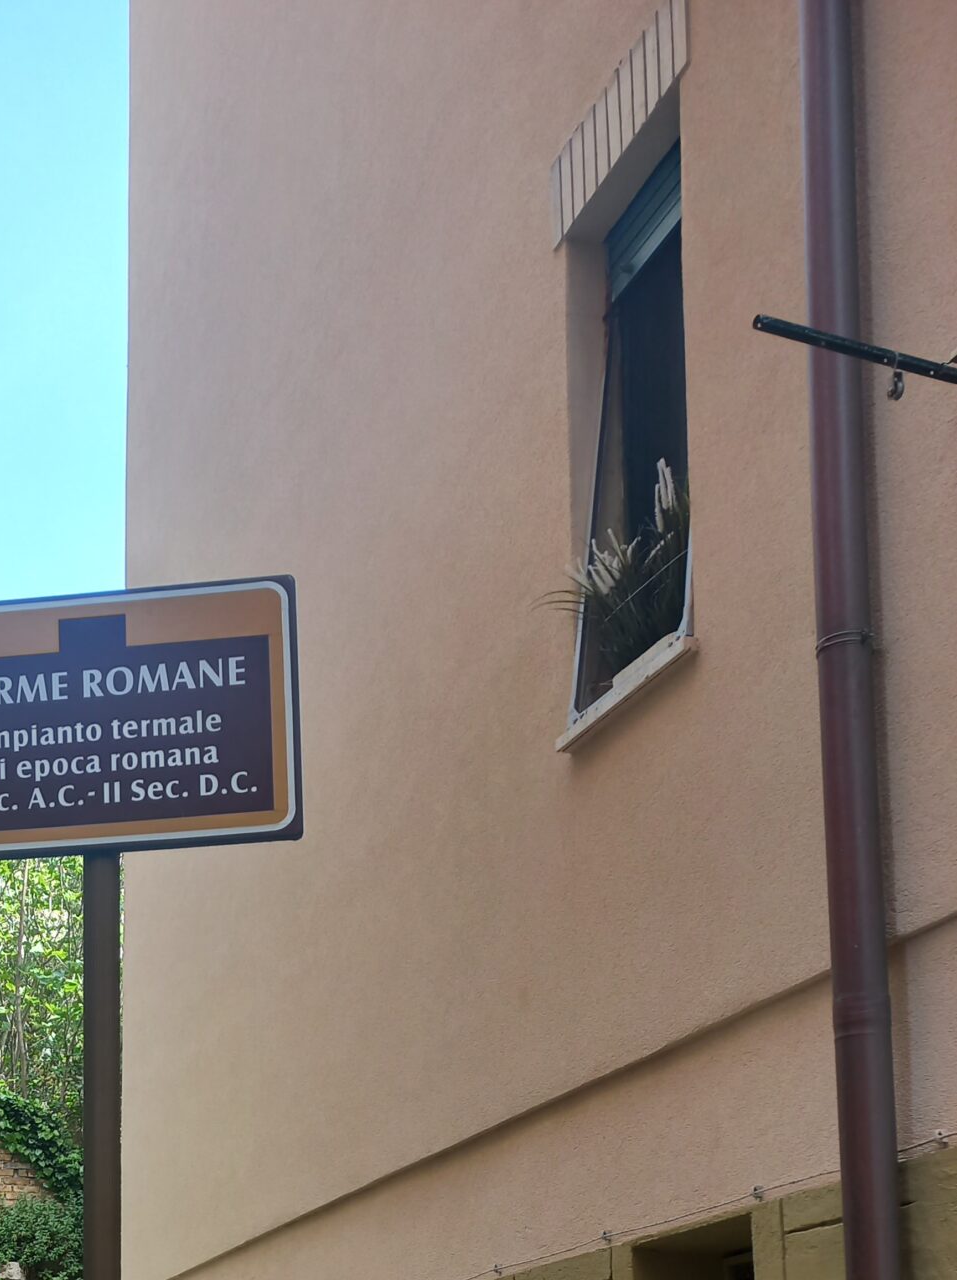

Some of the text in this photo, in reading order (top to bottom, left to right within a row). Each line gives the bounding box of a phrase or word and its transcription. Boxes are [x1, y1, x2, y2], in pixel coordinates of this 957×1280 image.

[82, 656, 247, 699] ROMANE
[110, 709, 222, 740] termale
[16, 754, 101, 782] epoca
[110, 745, 219, 772] romana
[130, 778, 189, 802] Sec.
[199, 770, 258, 797] D.C.
